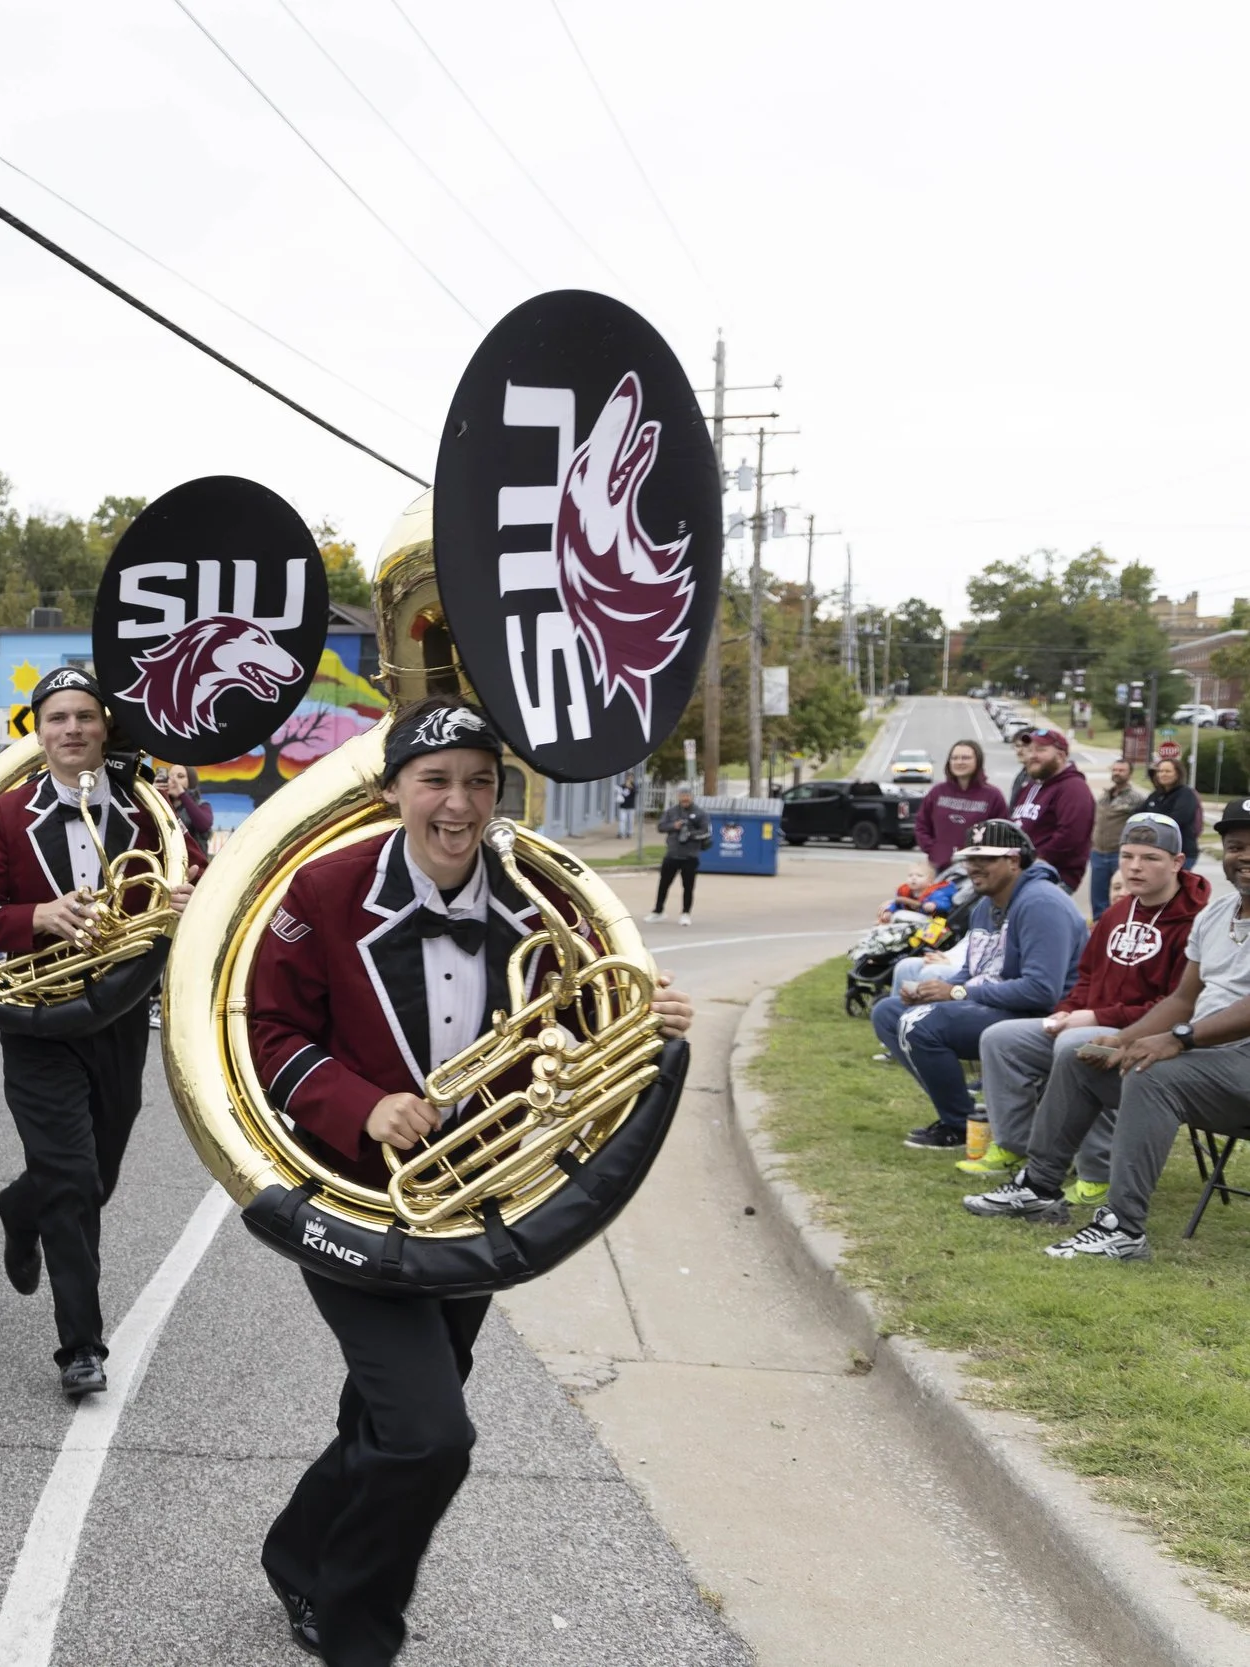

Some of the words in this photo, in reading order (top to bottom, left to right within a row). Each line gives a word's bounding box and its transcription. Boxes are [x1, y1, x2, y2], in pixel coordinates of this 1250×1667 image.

[498, 379, 592, 751] SIU
[117, 558, 308, 639] SIU
[104, 758, 127, 770] NG
[1159, 746, 1178, 755] STOP
[270, 906, 312, 943] IU
[302, 1232, 368, 1267] KING
